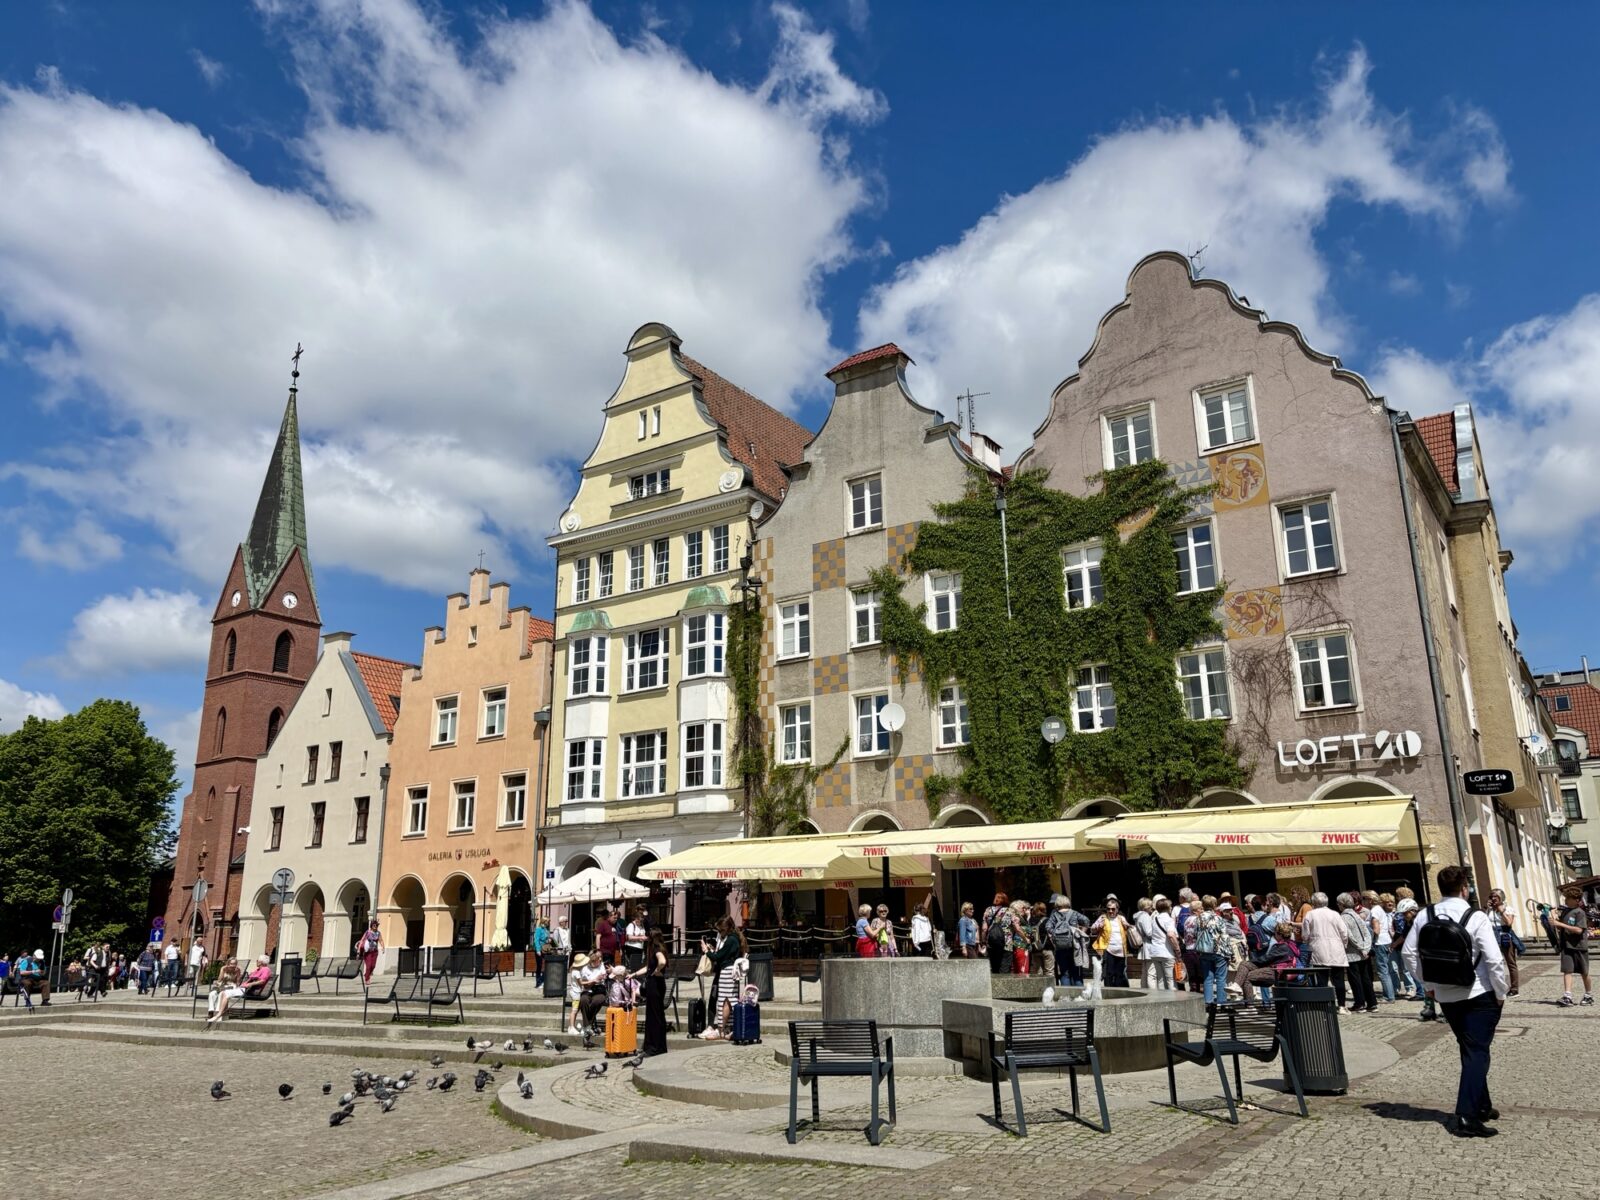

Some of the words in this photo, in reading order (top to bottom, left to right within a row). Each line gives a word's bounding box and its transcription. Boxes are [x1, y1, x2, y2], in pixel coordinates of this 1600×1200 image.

[1277, 733, 1367, 767] LOFT
[1469, 774, 1494, 783] LOFT
[1321, 833, 1361, 844] ŻYWIEC
